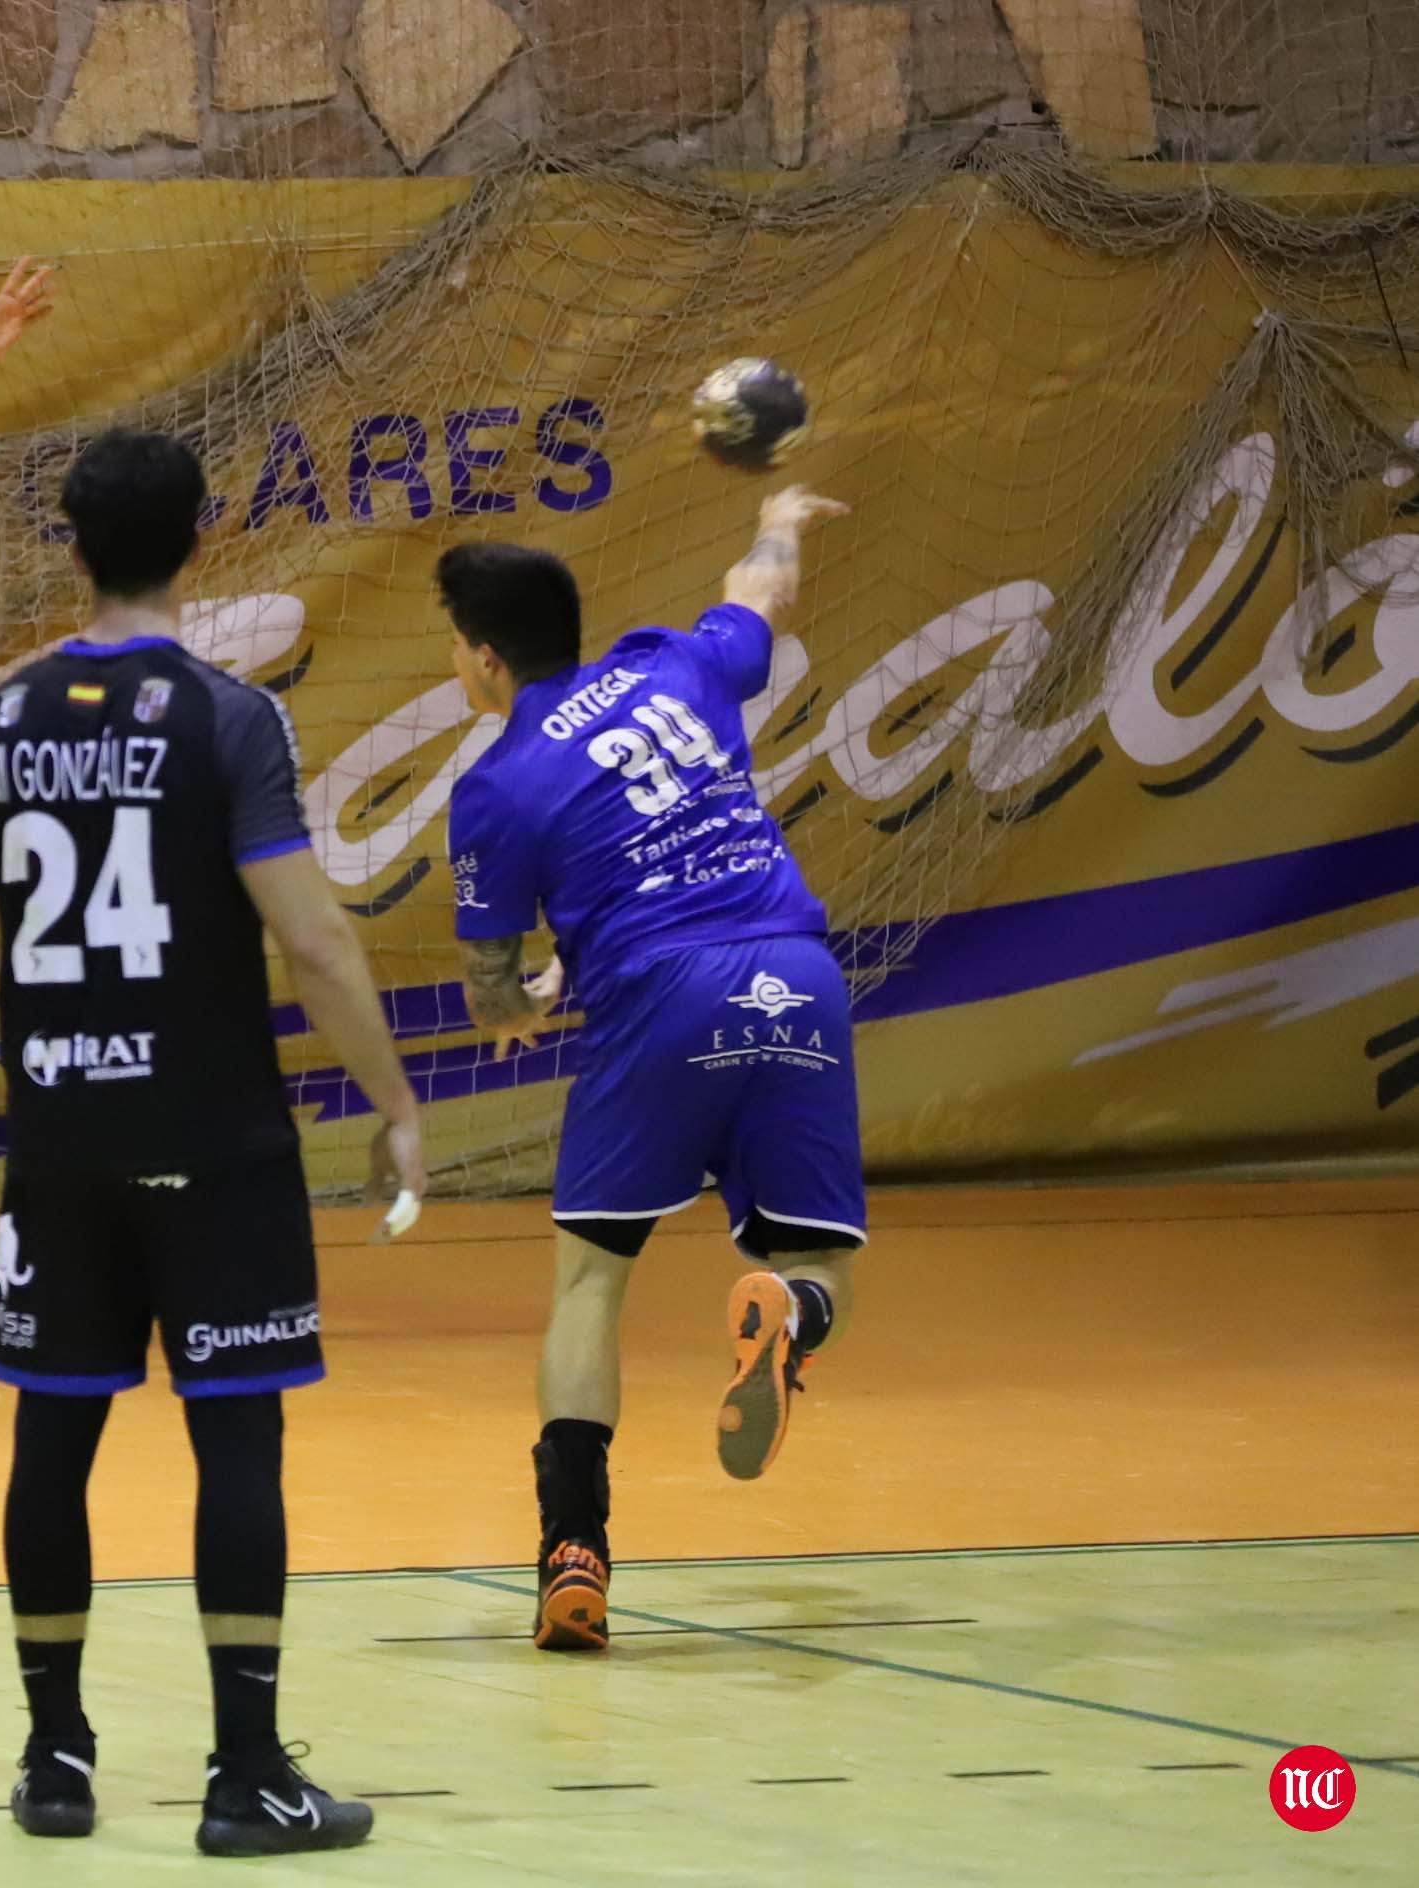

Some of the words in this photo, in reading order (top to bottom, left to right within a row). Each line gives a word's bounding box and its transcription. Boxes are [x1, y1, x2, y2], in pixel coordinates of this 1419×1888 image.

[542, 666, 647, 742] ORTEGA
[11, 725, 168, 802] GONZÁLEZ
[587, 693, 734, 817] 34
[0, 806, 172, 985] 24
[713, 1024, 823, 1050] ESNA
